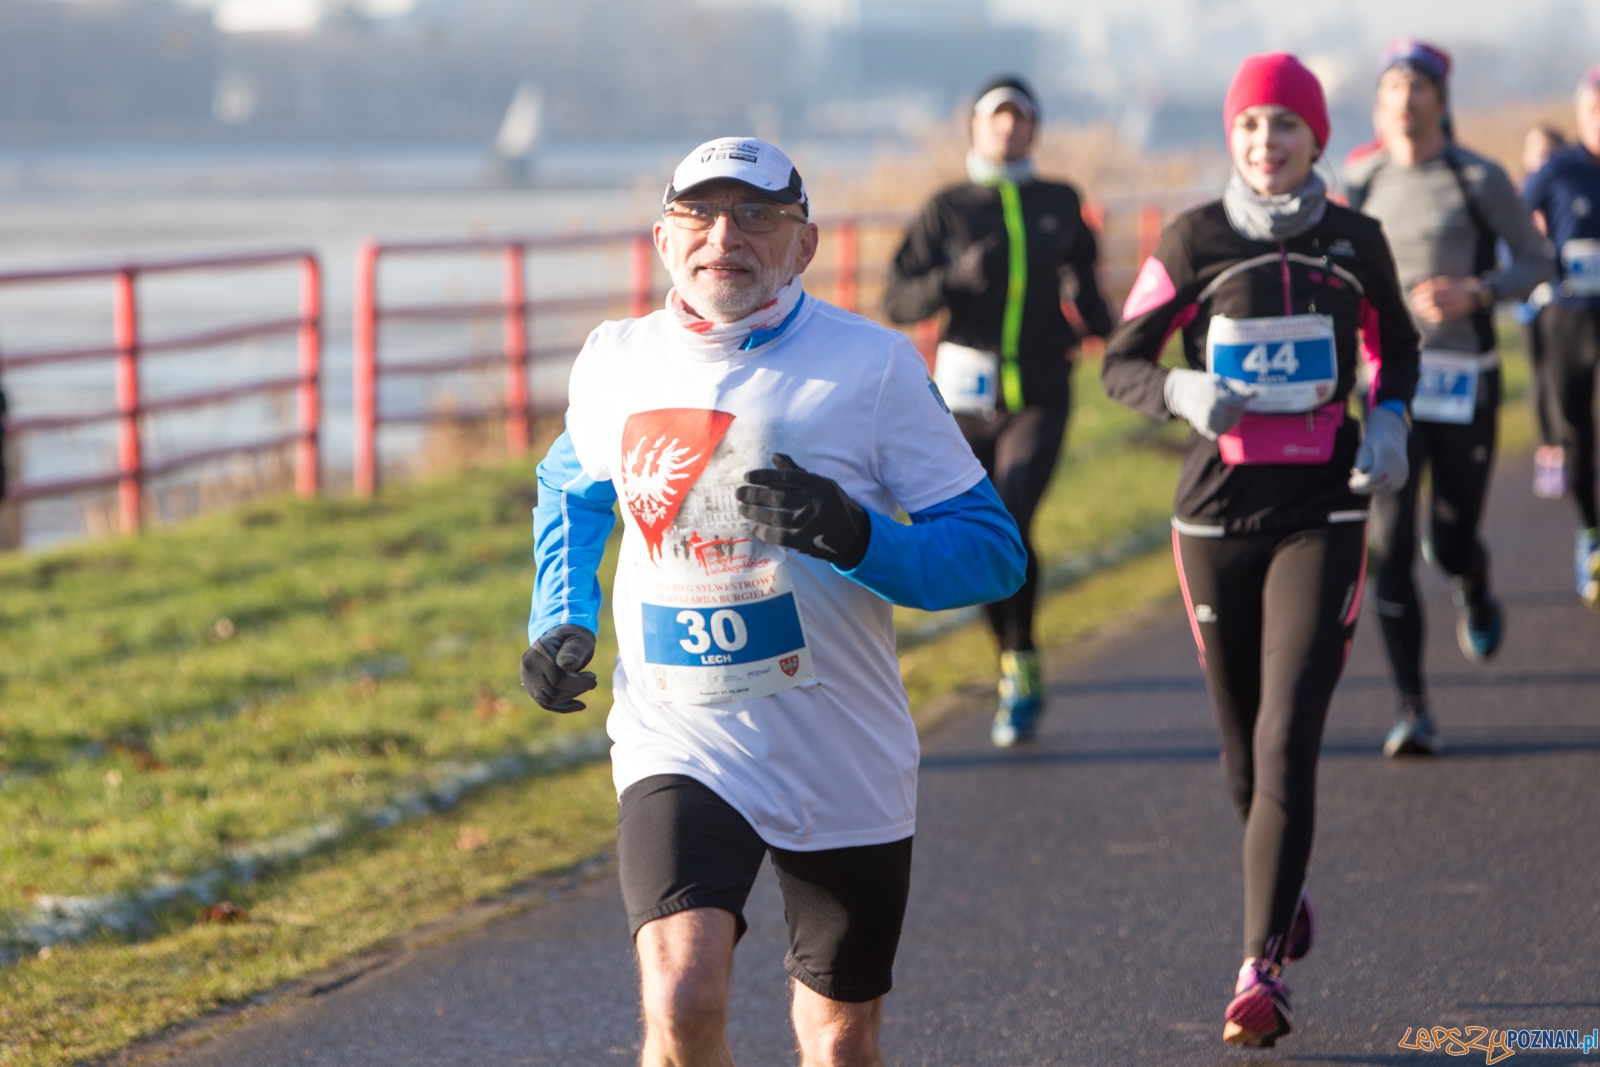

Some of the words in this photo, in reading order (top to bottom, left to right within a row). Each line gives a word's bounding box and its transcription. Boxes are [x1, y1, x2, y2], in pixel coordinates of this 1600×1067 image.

[1242, 341, 1299, 375] 44
[695, 572, 777, 592] SYLWESTROWY
[676, 608, 748, 655] 30
[700, 653, 732, 665] LECH
